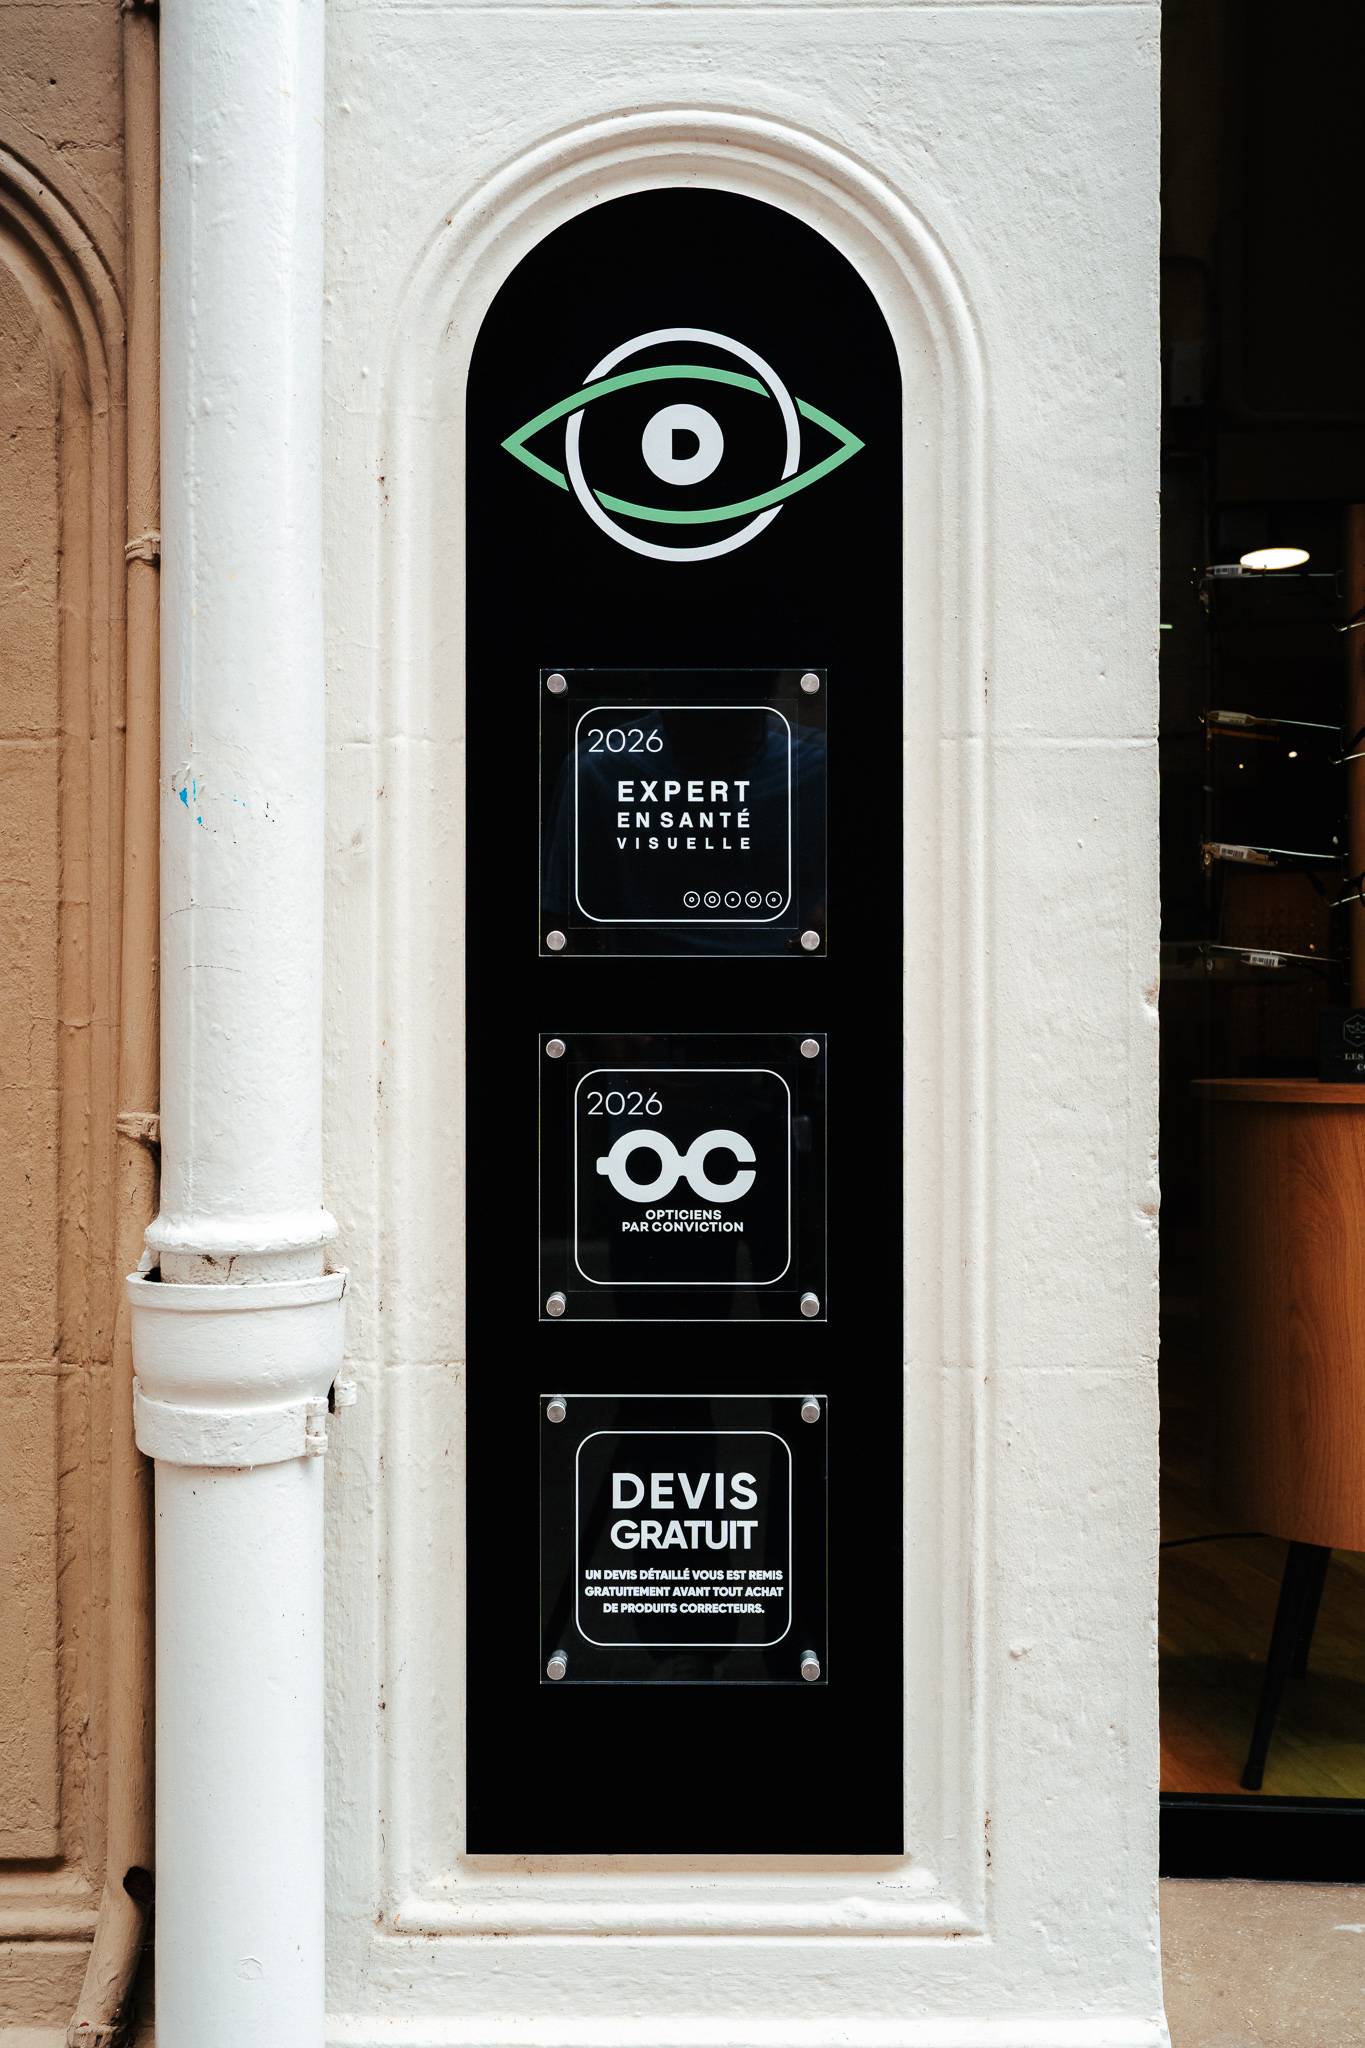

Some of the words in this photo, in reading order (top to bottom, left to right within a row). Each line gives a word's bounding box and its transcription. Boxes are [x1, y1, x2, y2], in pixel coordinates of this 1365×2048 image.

[587, 728, 664, 753] 2026
[617, 780, 750, 803] EXPERT
[617, 811, 651, 829] EN
[660, 807, 750, 829] SANTÉ
[616, 836, 751, 850] VISUELLE
[586, 1091, 663, 1116] 2026
[596, 1129, 757, 1203] OC
[645, 1209, 722, 1221] OPTICIENS
[621, 1221, 650, 1233] PAR
[651, 1221, 744, 1233] CONVICTION
[612, 1471, 758, 1510] DEVIS
[610, 1519, 759, 1550] GRATUIT
[585, 1569, 602, 1581] UN
[603, 1569, 638, 1581] DEVIS
[639, 1567, 690, 1581] DÉTAILLÉ
[692, 1569, 725, 1581] VOUS
[726, 1569, 748, 1581] EST
[748, 1569, 784, 1581] REMIS
[584, 1585, 671, 1598] GRATUITEMENT
[672, 1585, 712, 1598] AVANT
[712, 1585, 743, 1598] TOUT
[744, 1585, 784, 1598] ACHAT
[602, 1602, 619, 1614] DE
[620, 1602, 678, 1614] PRODUITS
[679, 1602, 766, 1614] CORRECTEURS.
